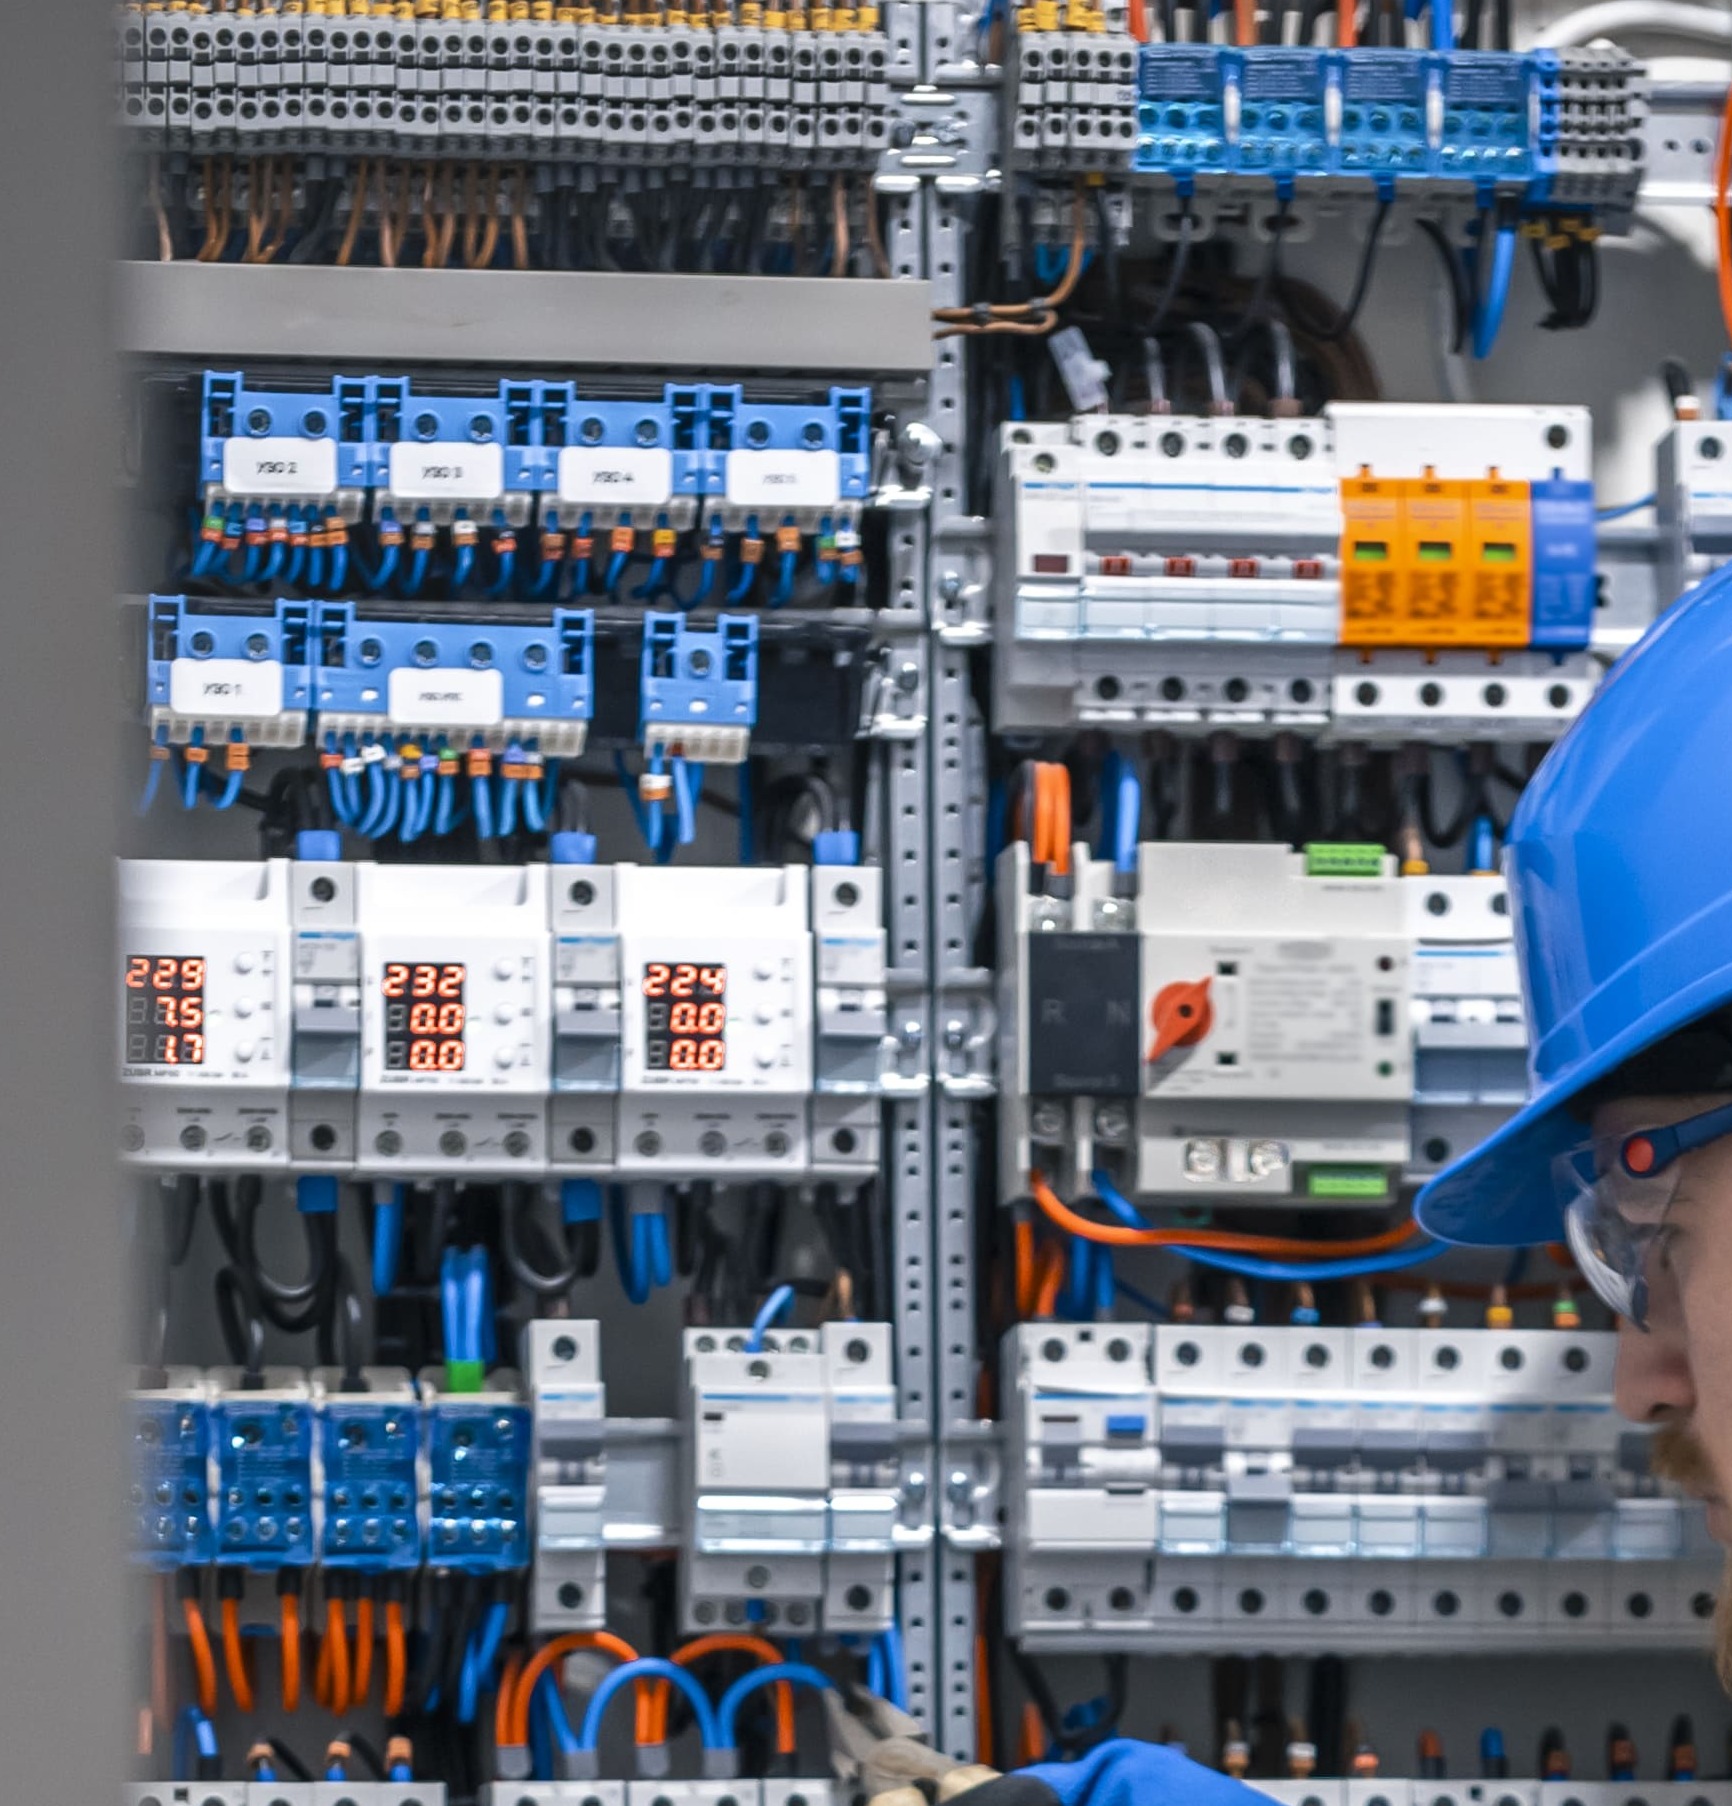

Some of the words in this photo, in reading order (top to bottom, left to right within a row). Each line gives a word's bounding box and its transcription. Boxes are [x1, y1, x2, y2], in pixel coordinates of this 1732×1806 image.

[126, 958, 206, 990] 229
[382, 964, 466, 997] 232
[642, 963, 726, 997] 224
